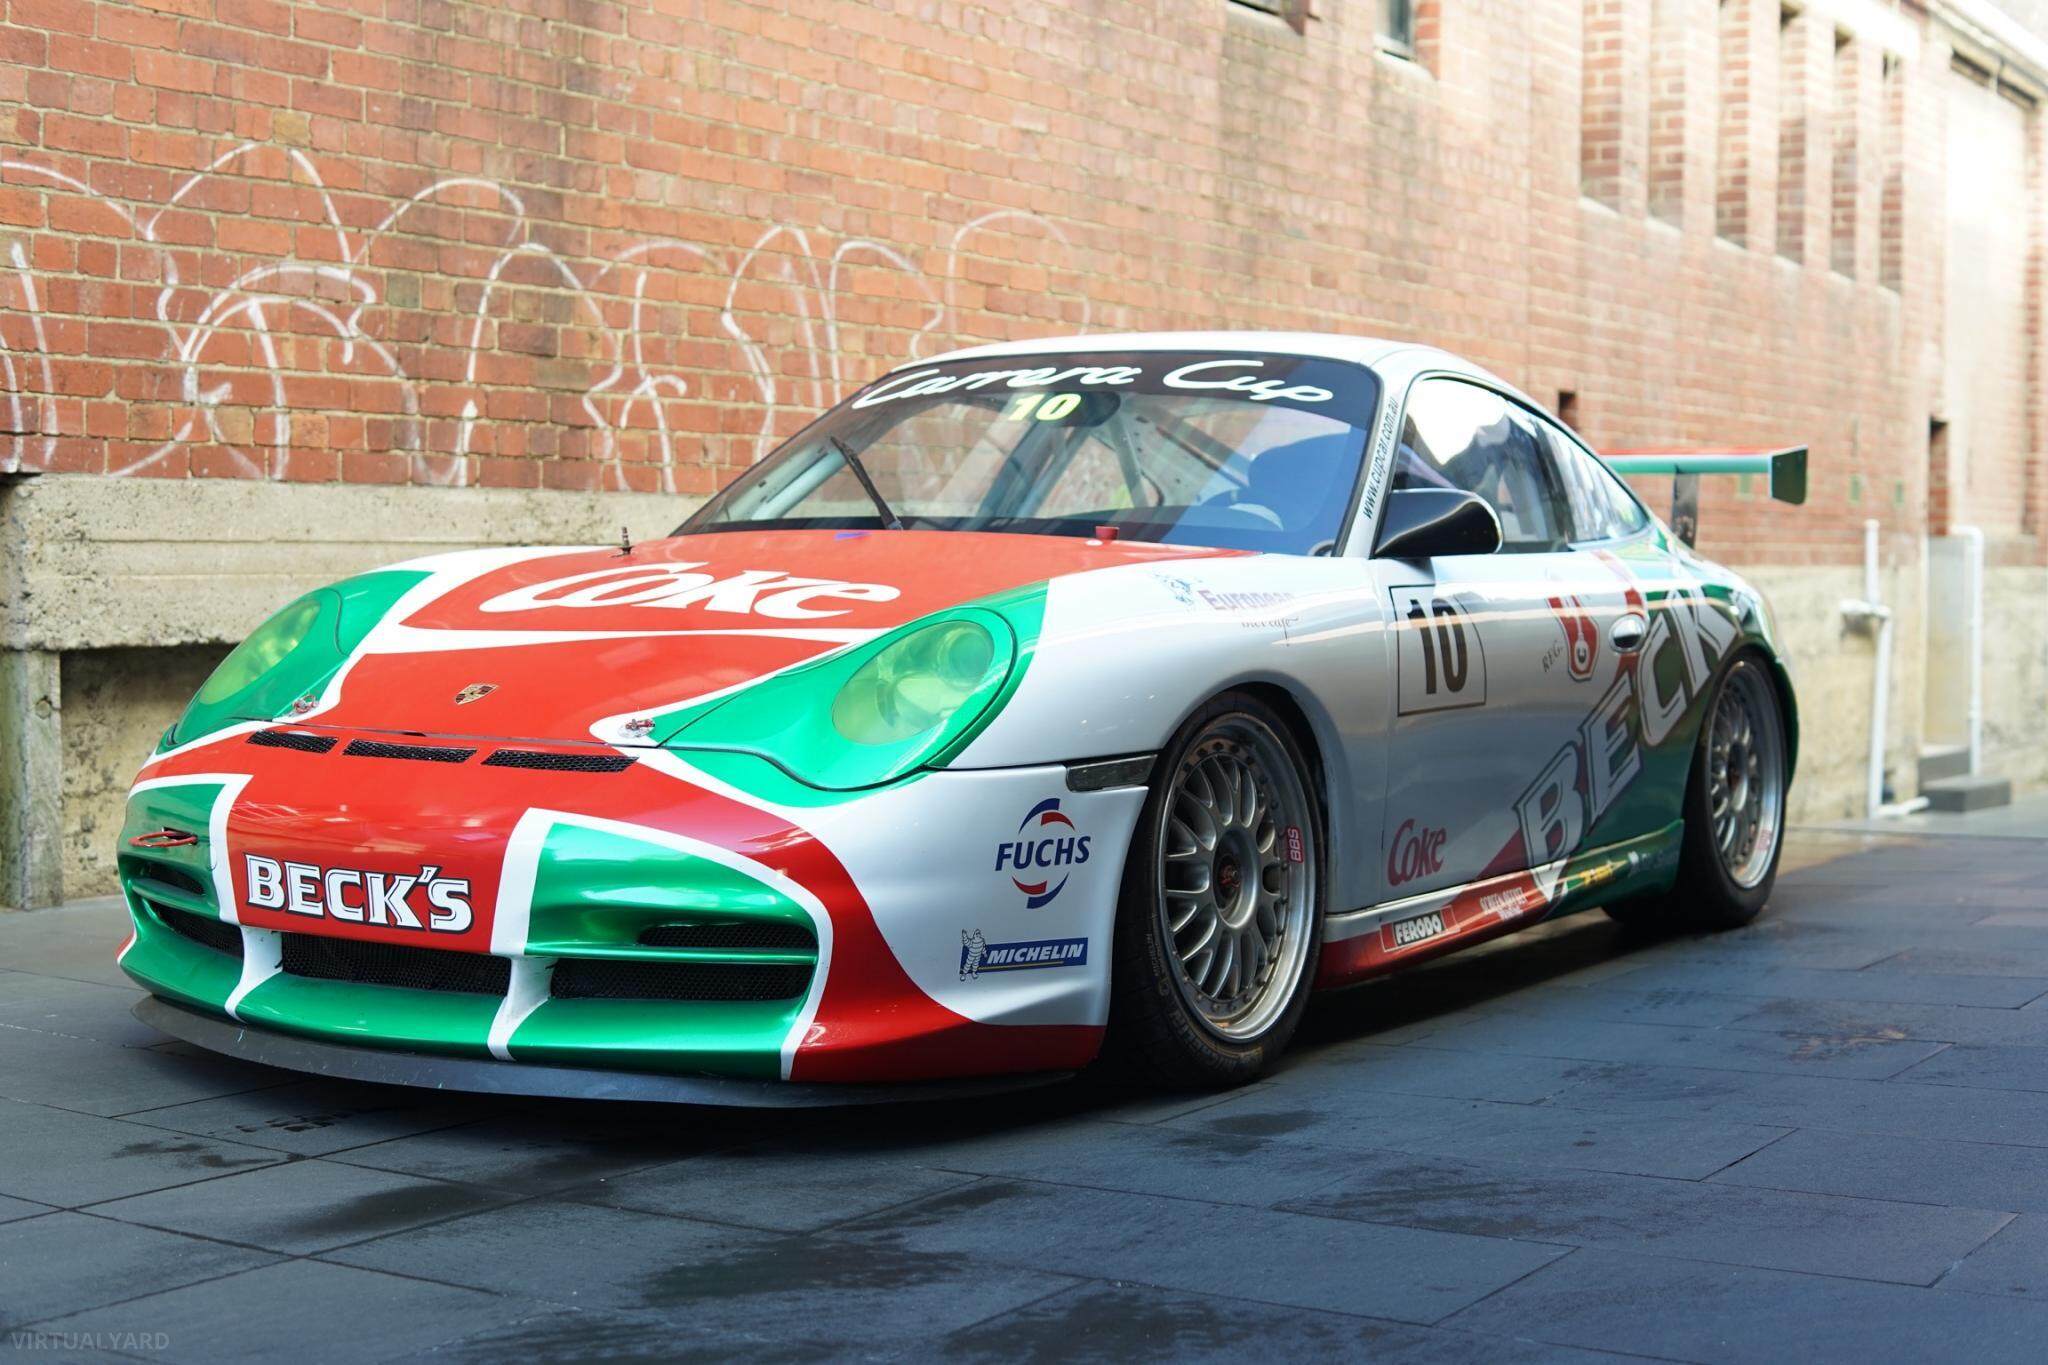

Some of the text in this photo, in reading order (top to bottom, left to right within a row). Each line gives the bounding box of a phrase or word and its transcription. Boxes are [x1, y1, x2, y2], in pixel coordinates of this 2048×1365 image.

[853, 360, 1333, 410] Carrera Cup
[1008, 393, 1082, 421] 10
[1362, 396, 1399, 520] www.cupcar.com.au
[478, 562, 901, 619] Coke
[1406, 597, 1468, 695] 10
[996, 835, 1091, 871] FUCHS
[1288, 828, 1302, 861] BBS
[1387, 818, 1446, 887] Coke
[244, 853, 473, 935] BECK'S
[987, 942, 1085, 965] MICHELIN
[1395, 914, 1442, 945] FERODO
